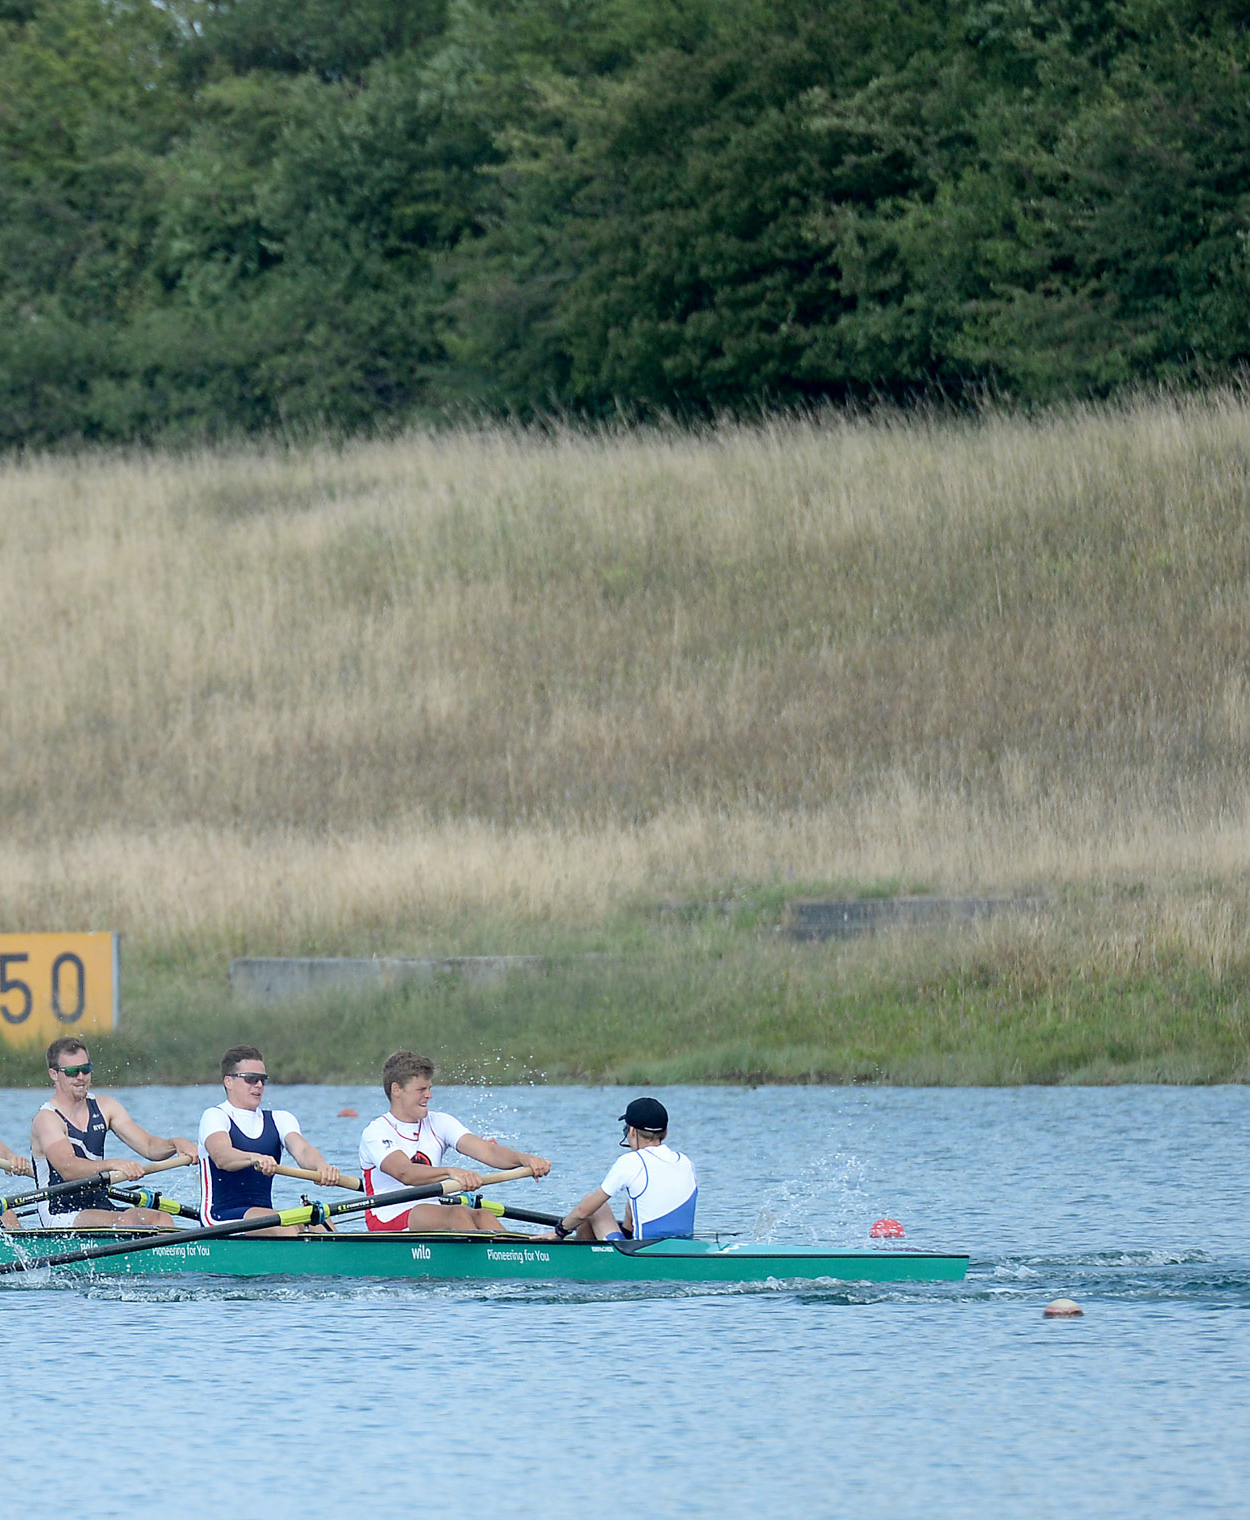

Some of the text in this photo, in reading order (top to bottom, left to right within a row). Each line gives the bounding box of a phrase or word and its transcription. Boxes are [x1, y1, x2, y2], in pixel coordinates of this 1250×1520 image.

[186, 1244, 196, 1256] for
[196, 1245, 211, 1256] You
[411, 1244, 431, 1260] wilo
[487, 1249, 550, 1264] Pioneering for You
